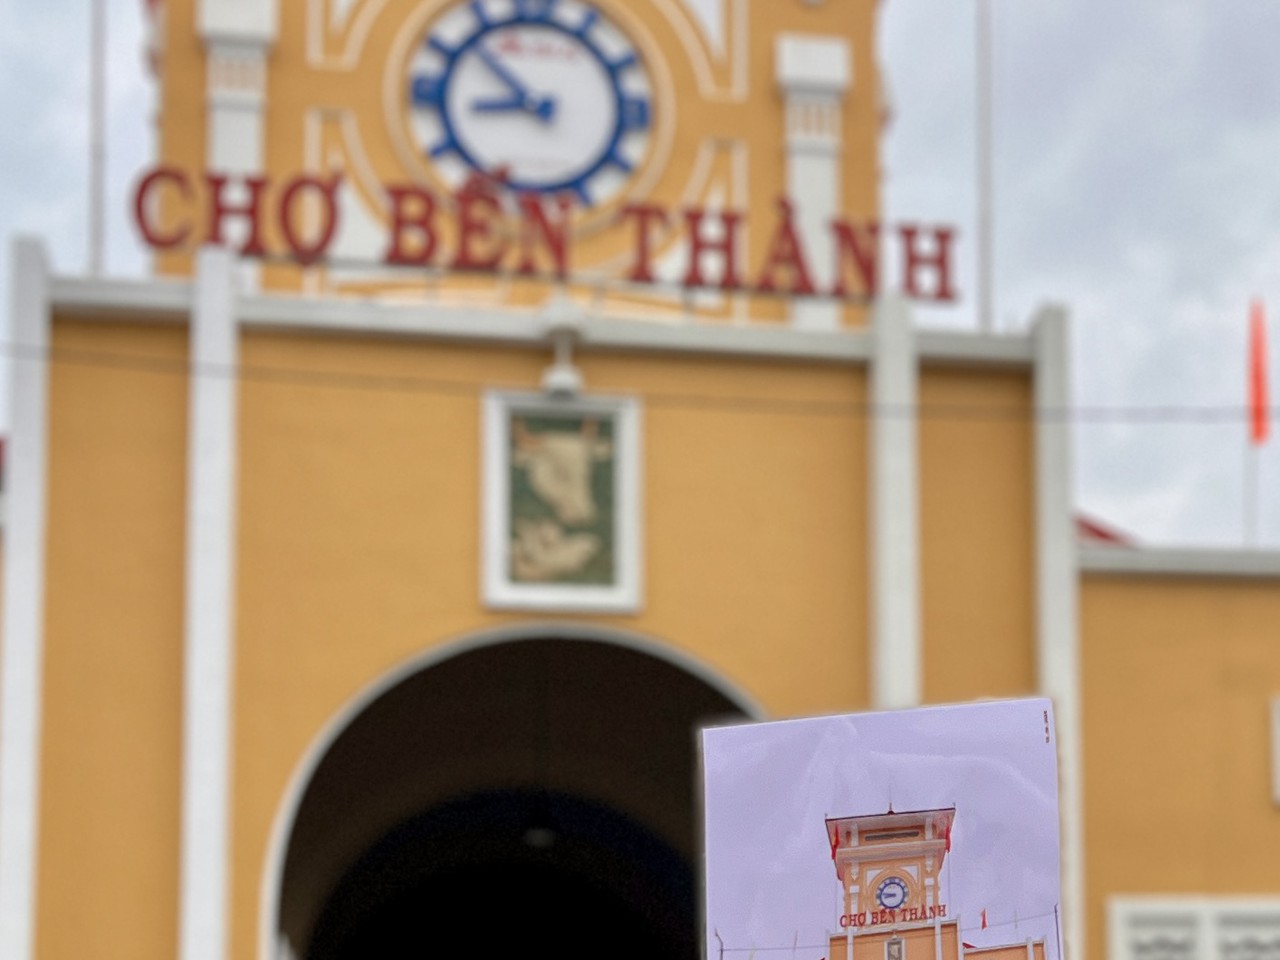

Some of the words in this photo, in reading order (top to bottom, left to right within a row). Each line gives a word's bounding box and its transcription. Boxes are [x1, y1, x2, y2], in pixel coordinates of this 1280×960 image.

[132, 166, 344, 266] CHỢ
[384, 162, 571, 281] BẾN
[620, 196, 958, 302] THÀNH
